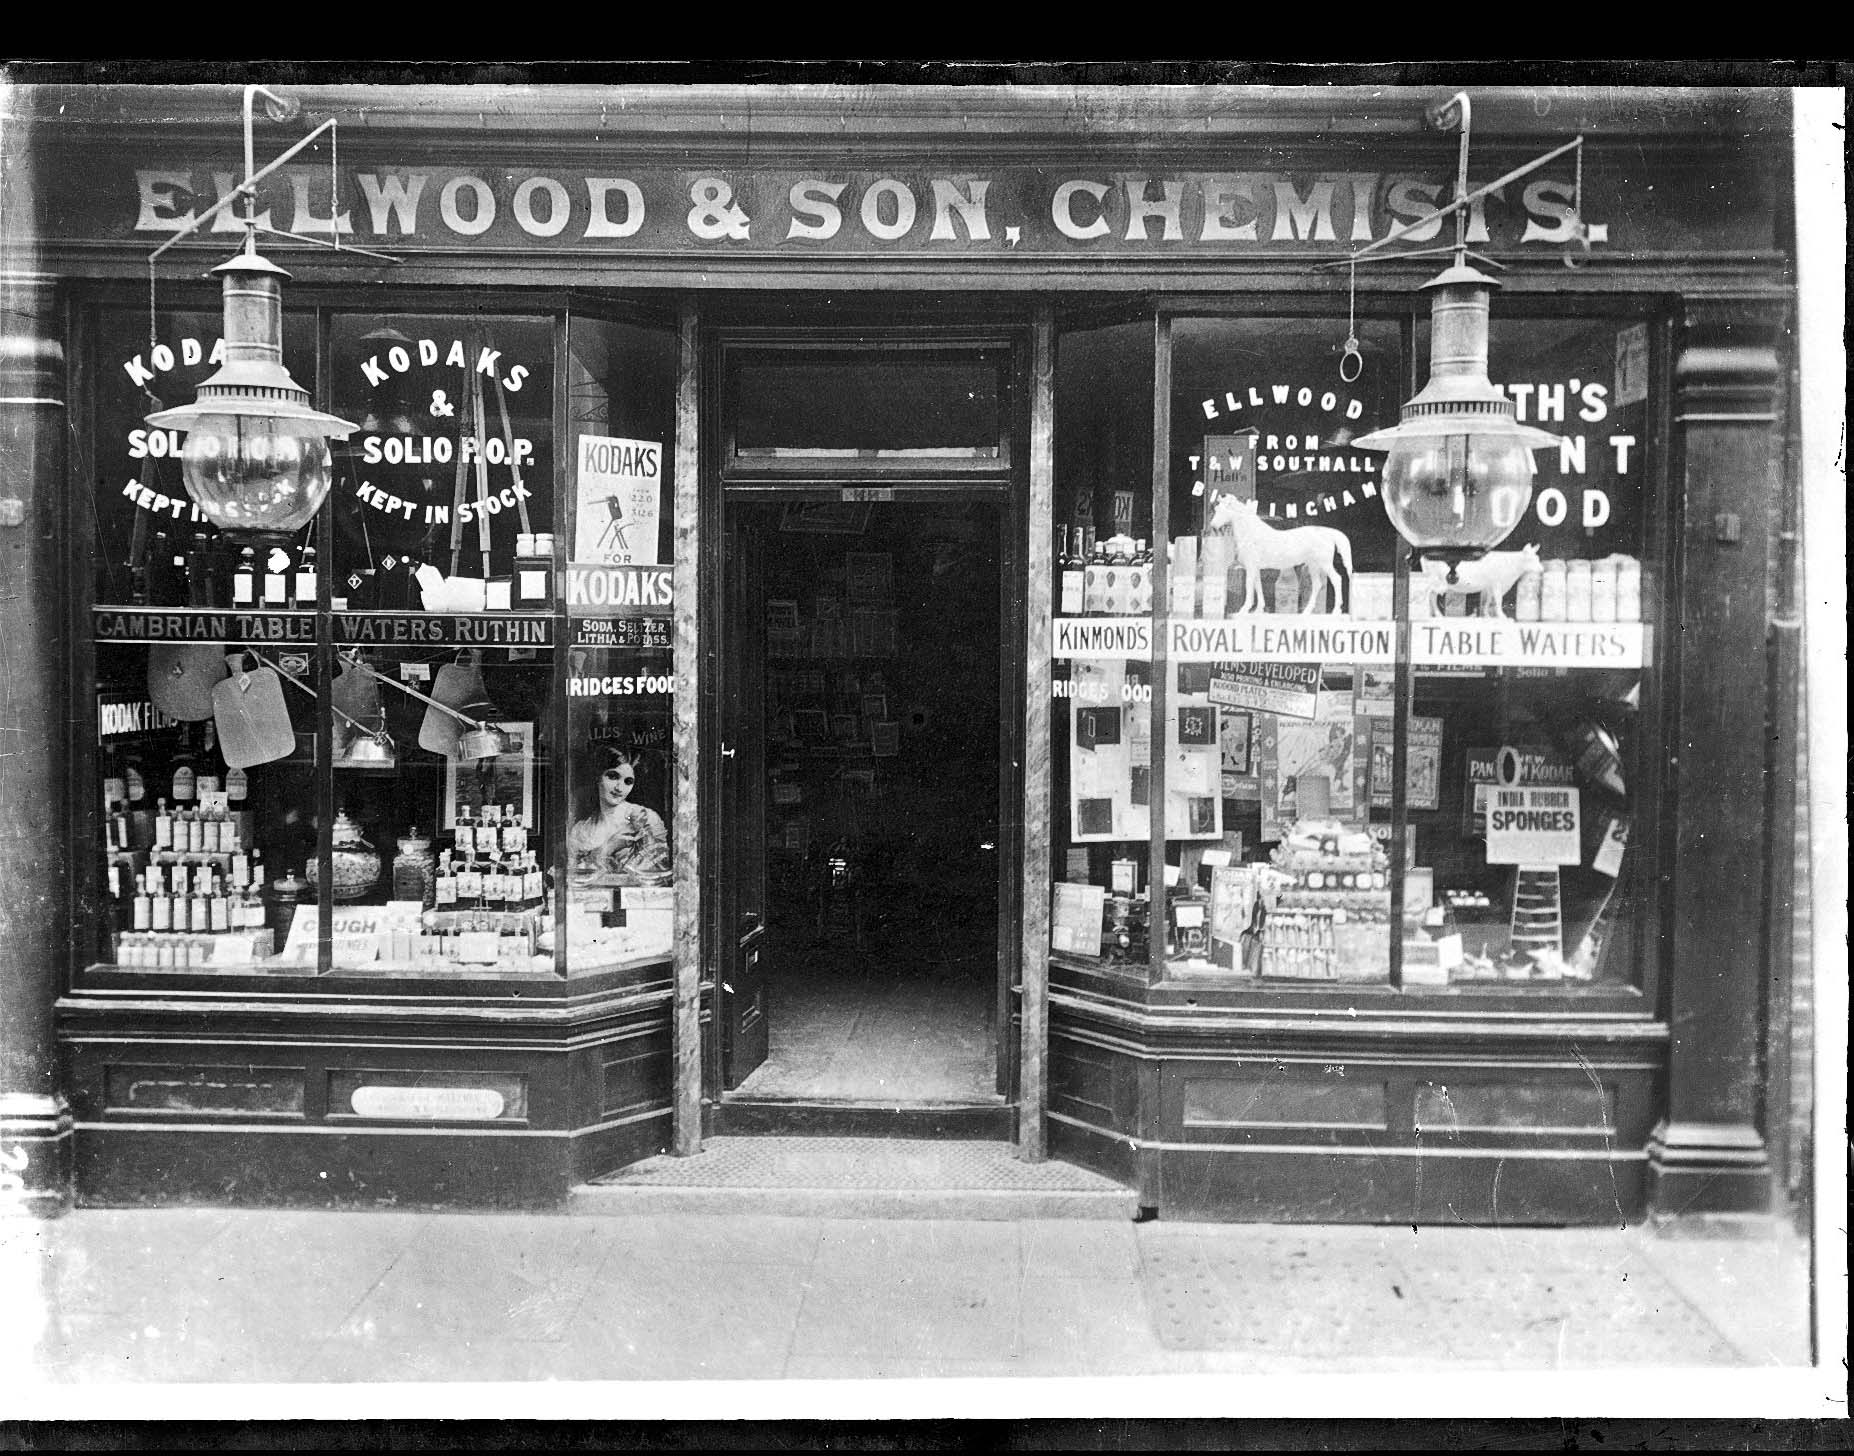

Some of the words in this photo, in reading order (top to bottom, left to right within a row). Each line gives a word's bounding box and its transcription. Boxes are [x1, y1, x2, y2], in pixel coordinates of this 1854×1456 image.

[134, 170, 645, 238] ELLWOOD
[687, 178, 750, 240] &
[786, 177, 1021, 246] SON,
[1052, 178, 1608, 243] CHEMISTS.
[360, 339, 530, 392] KODAKS
[429, 389, 454, 417] &
[1202, 385, 1363, 420] ELLWOOD
[363, 436, 453, 464] SOLIO
[461, 437, 535, 466] P.O.P.
[1248, 435, 1319, 450] FROM
[584, 442, 658, 478] KODAKS
[1188, 455, 1200, 471] T
[1209, 456, 1221, 471] &
[1229, 456, 1243, 471] W
[1257, 456, 1376, 472] SOUTHALL
[122, 478, 186, 519] KEPT
[356, 480, 418, 521] KEPT
[424, 505, 449, 524] IN
[457, 479, 533, 523] STOCK
[603, 554, 632, 564] FOR
[566, 569, 674, 606] KODAKS
[96, 613, 227, 639] CAMBRIAN
[235, 615, 313, 640] TABLE
[340, 616, 450, 642] WATERS.
[455, 617, 547, 643] RUTHIN
[577, 631, 618, 644] LITHIA
[619, 635, 625, 644] &
[1059, 621, 1148, 650] KINMOND'S
[1173, 623, 1243, 653] ROYAL
[1251, 624, 1390, 654] LEAMINGTON
[1421, 625, 1503, 656] TABLE
[1520, 627, 1626, 656] WATERS
[1250, 661, 1317, 684] DEVELOPED
[101, 702, 142, 736] KODAK
[631, 727, 667, 746] WINE
[1497, 791, 1525, 808] INDIA
[1530, 791, 1570, 808] RUBBER
[1491, 810, 1576, 831] SPONGES
[302, 919, 378, 934] CUGH
